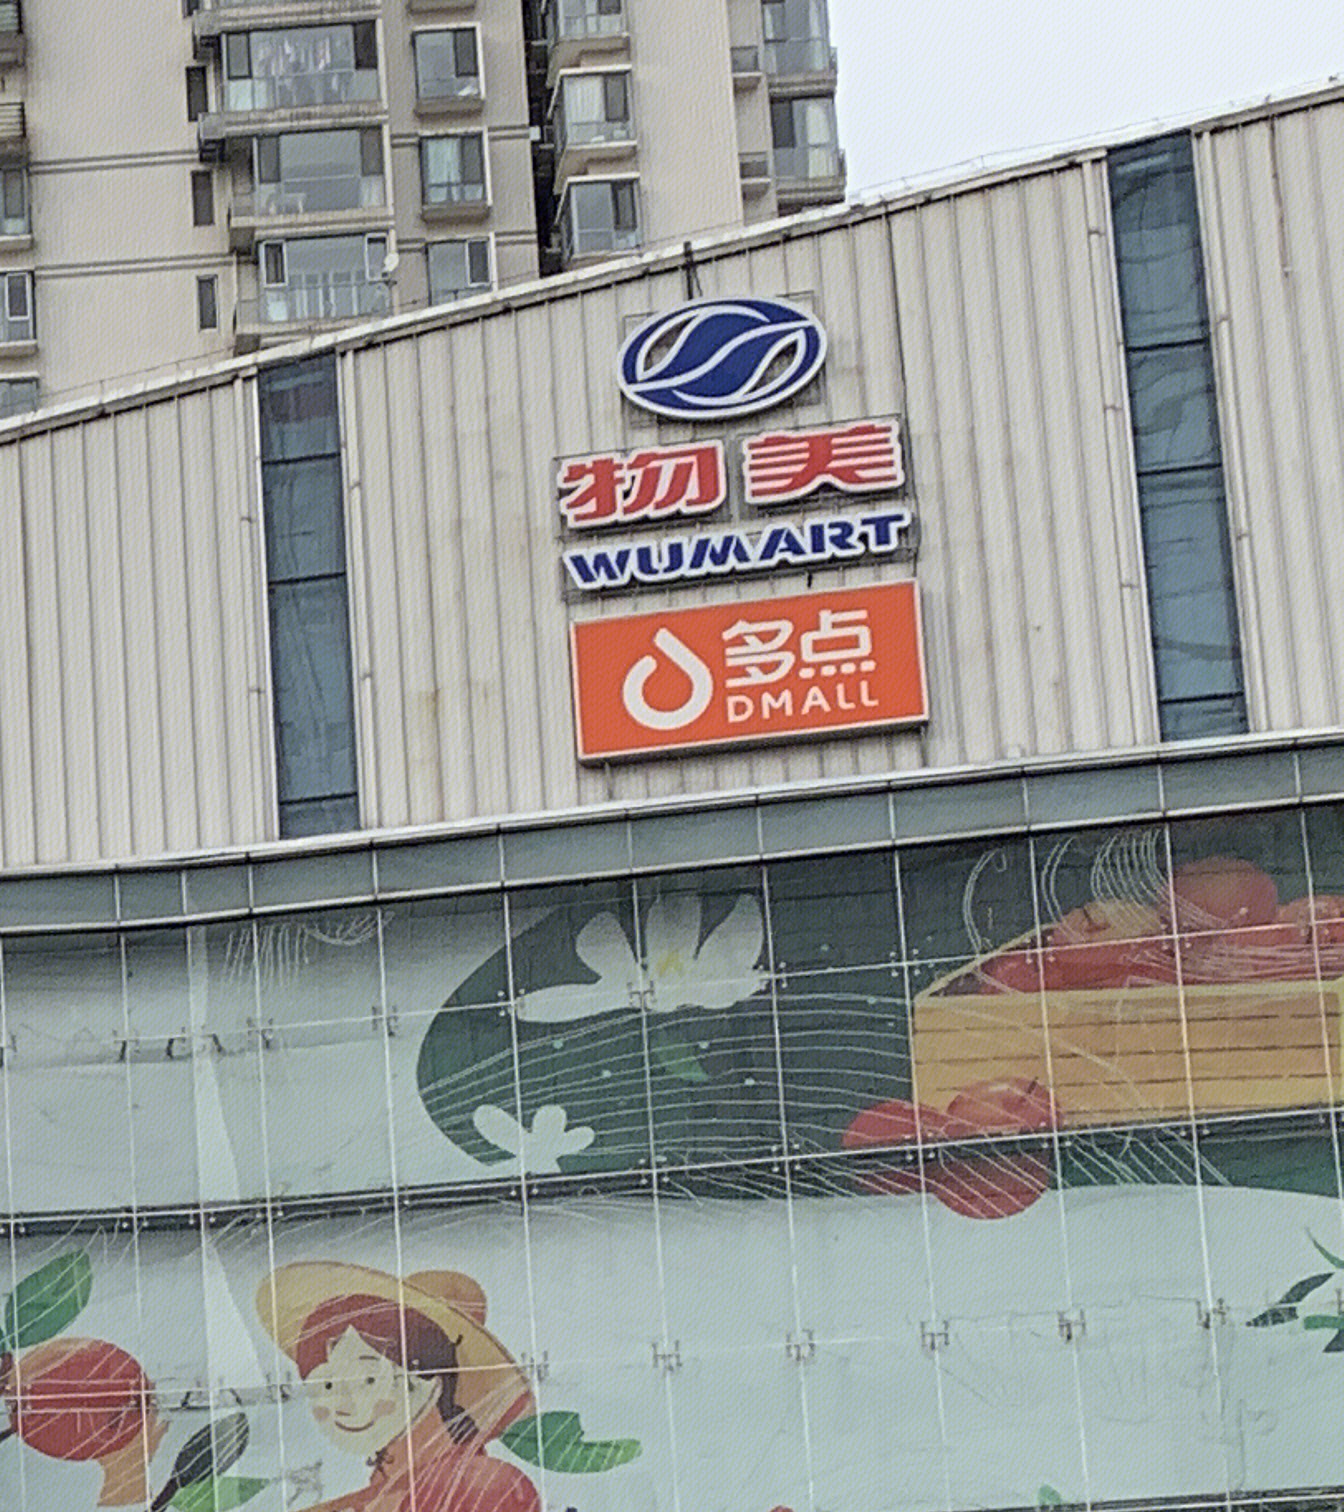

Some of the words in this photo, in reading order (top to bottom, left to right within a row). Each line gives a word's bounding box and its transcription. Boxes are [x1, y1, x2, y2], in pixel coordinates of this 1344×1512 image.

[561, 421, 902, 526] 物美
[566, 511, 908, 588] WUMART
[722, 609, 877, 688] 多点
[726, 680, 879, 723] DMALL
